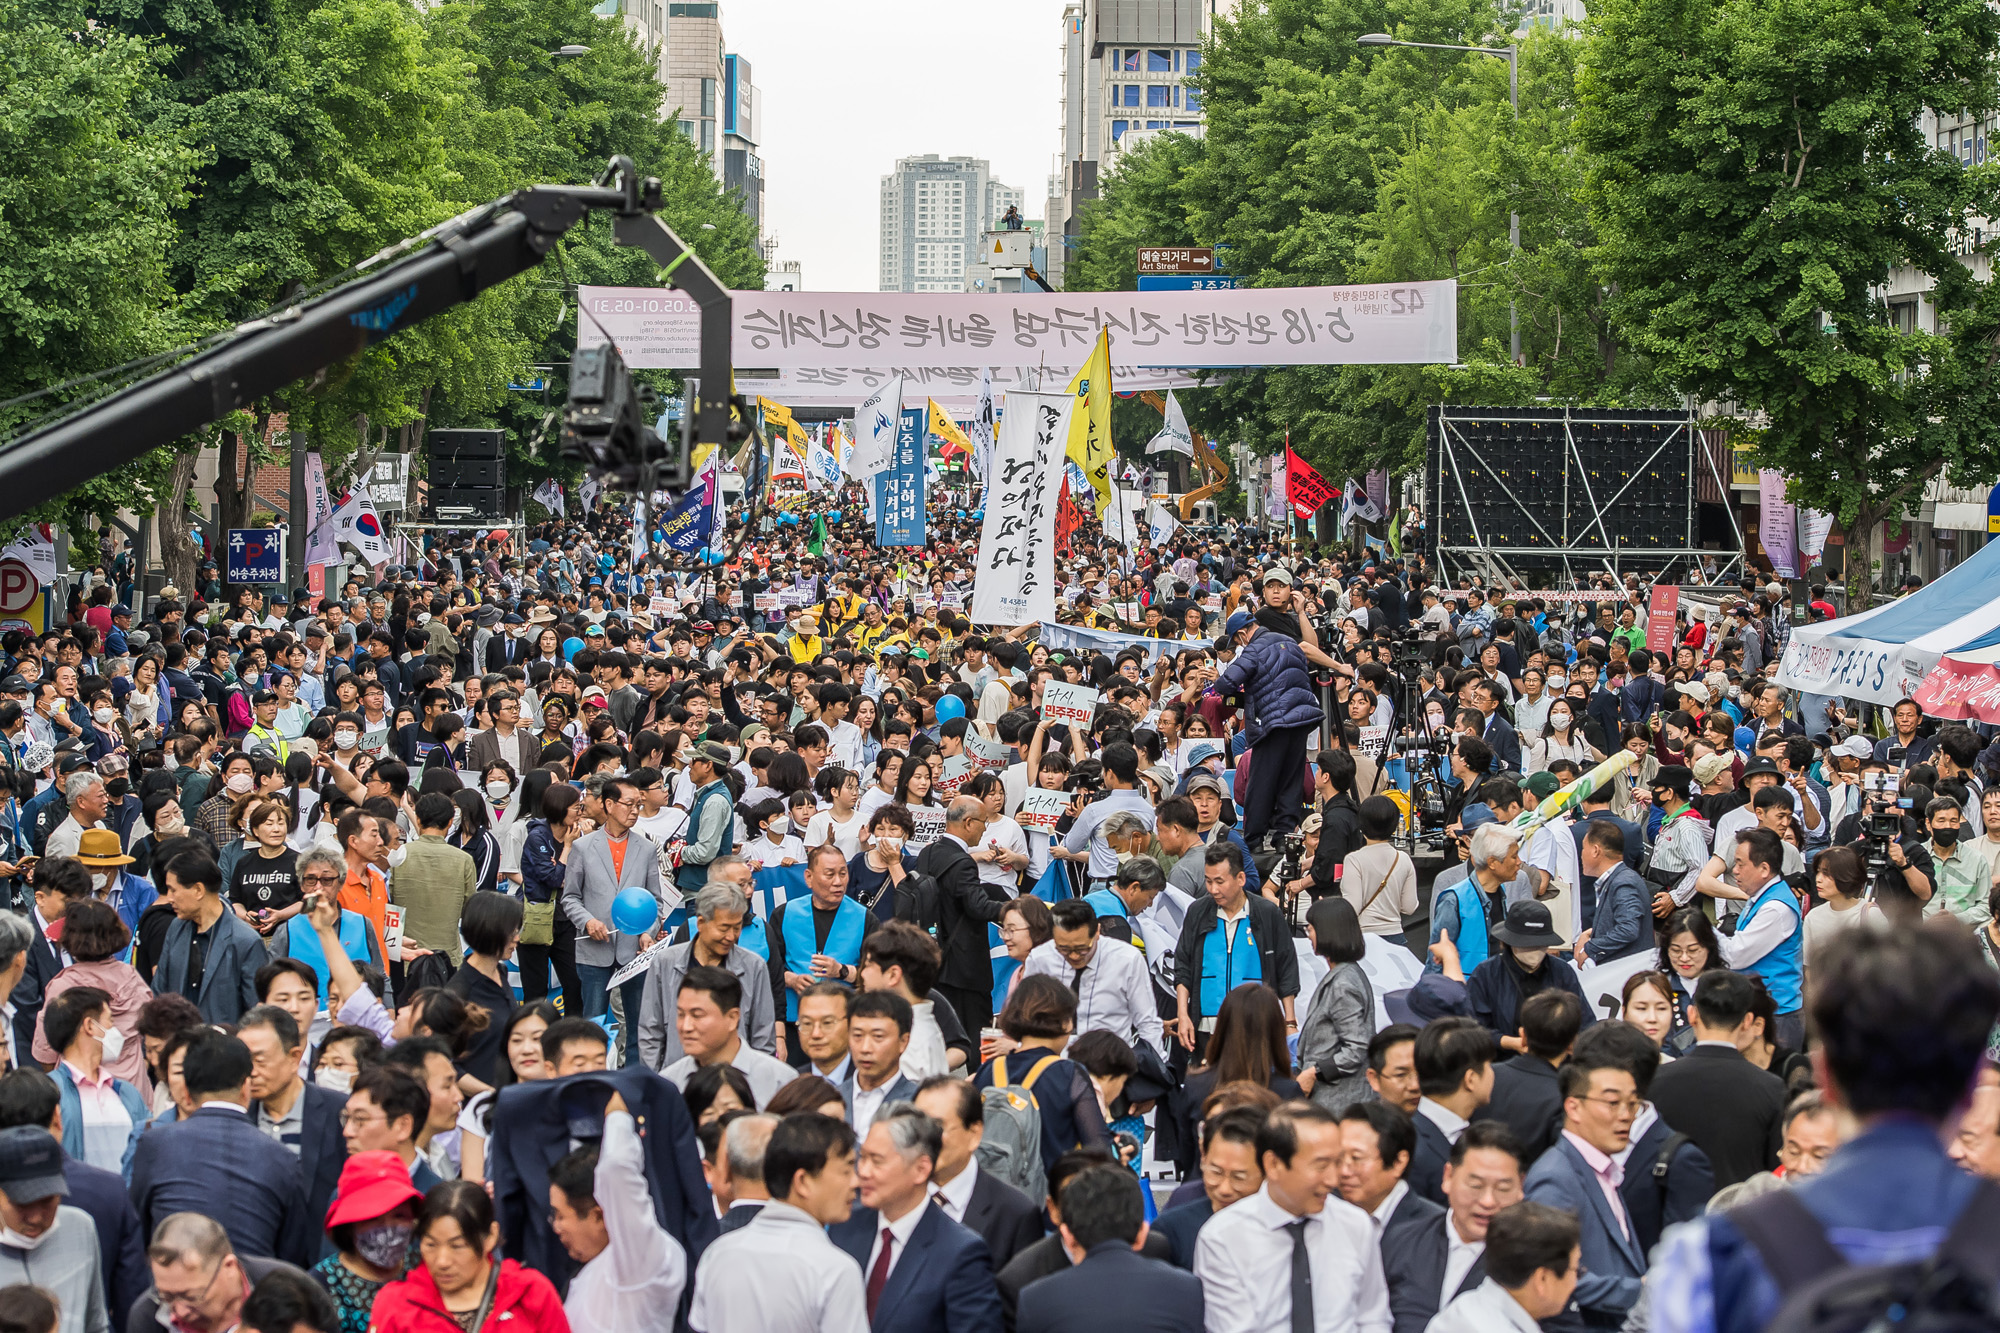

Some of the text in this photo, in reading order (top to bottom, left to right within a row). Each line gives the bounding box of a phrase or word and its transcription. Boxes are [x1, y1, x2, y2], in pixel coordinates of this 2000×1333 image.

[1141, 250, 1190, 265] 예술의거리
[899, 415, 916, 522] 민주를 구하라
[883, 478, 900, 528] 지켜라
[245, 542, 264, 566] P
[229, 567, 279, 580] 아송주차장
[0, 568, 28, 607] P
[1827, 649, 1888, 692] PRESS
[1047, 687, 1074, 706] 다시,
[1044, 704, 1092, 723] 민주주의!
[966, 733, 987, 756] 다시,
[965, 746, 1007, 768] 민주주의!
[1028, 795, 1058, 814] 다시,
[242, 869, 292, 885] LUMIÉRE
